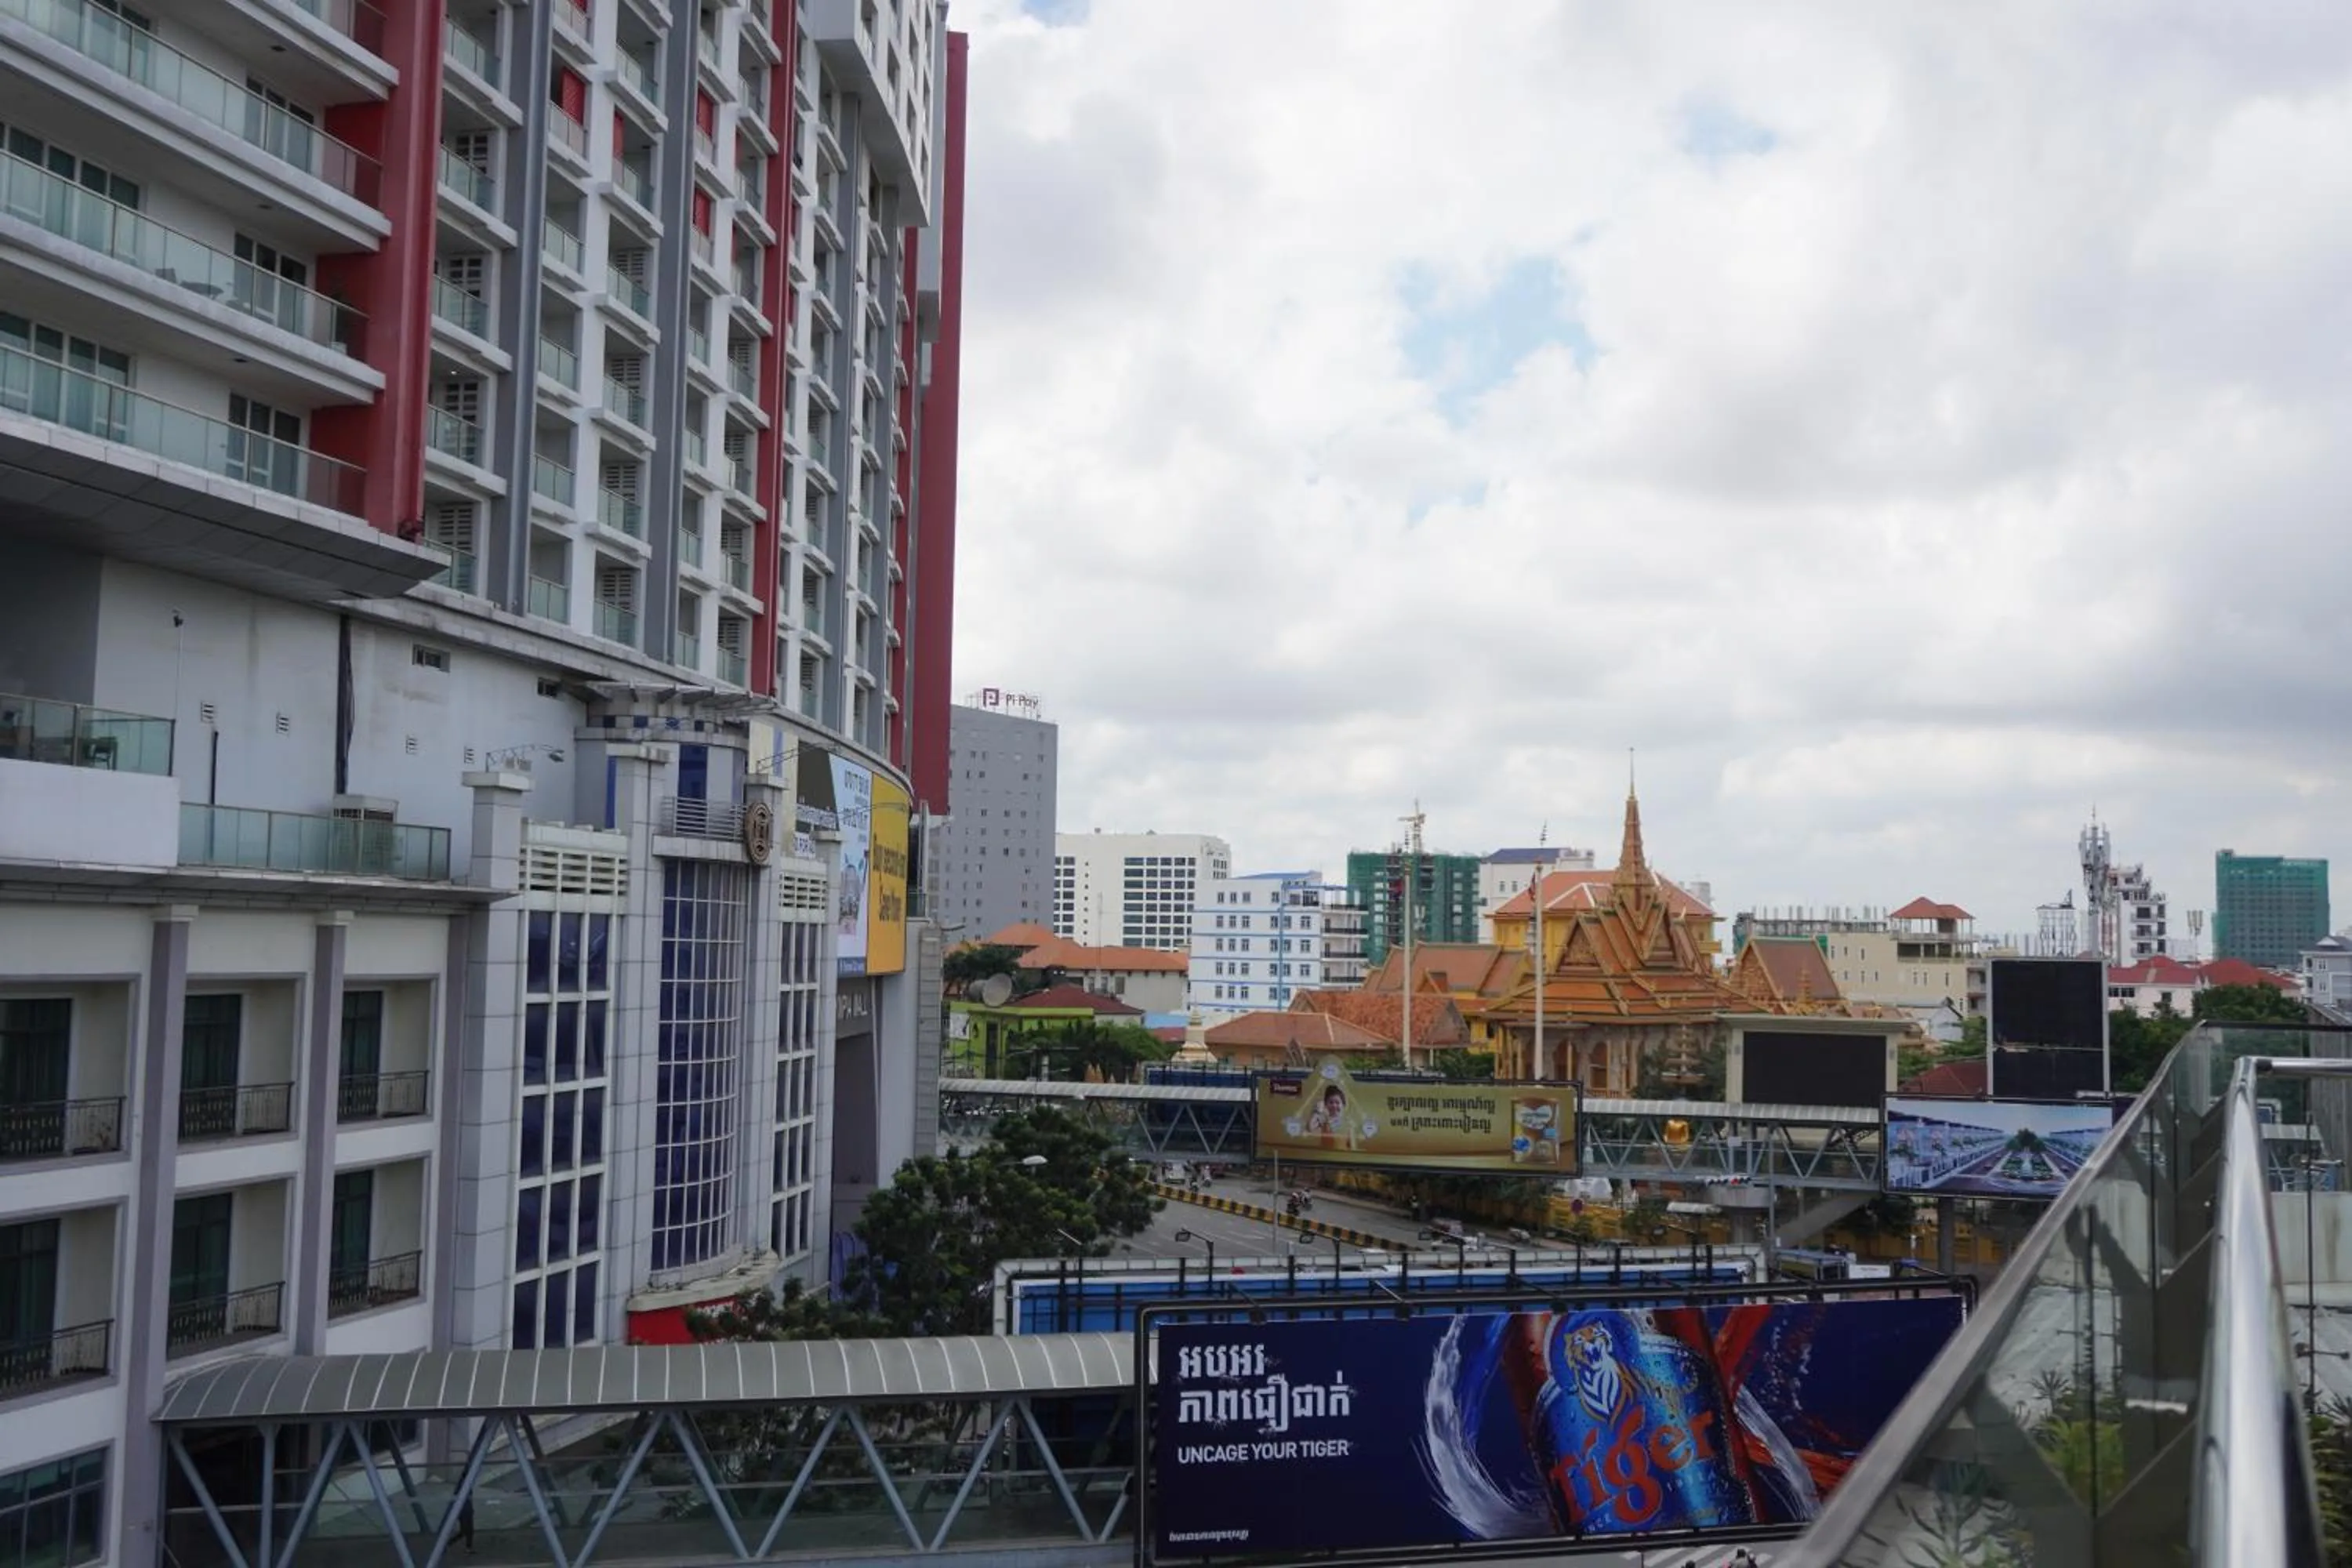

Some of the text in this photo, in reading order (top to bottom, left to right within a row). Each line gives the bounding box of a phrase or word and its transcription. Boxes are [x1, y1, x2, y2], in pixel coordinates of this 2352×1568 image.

[1178, 1344, 1265, 1378] អបអរ
[1178, 1370, 1347, 1432] ភាពជឿជាក់
[1178, 1439, 1349, 1464] UNCAGE YOUR TIGER
[1549, 1404, 1714, 1524] Tiger
